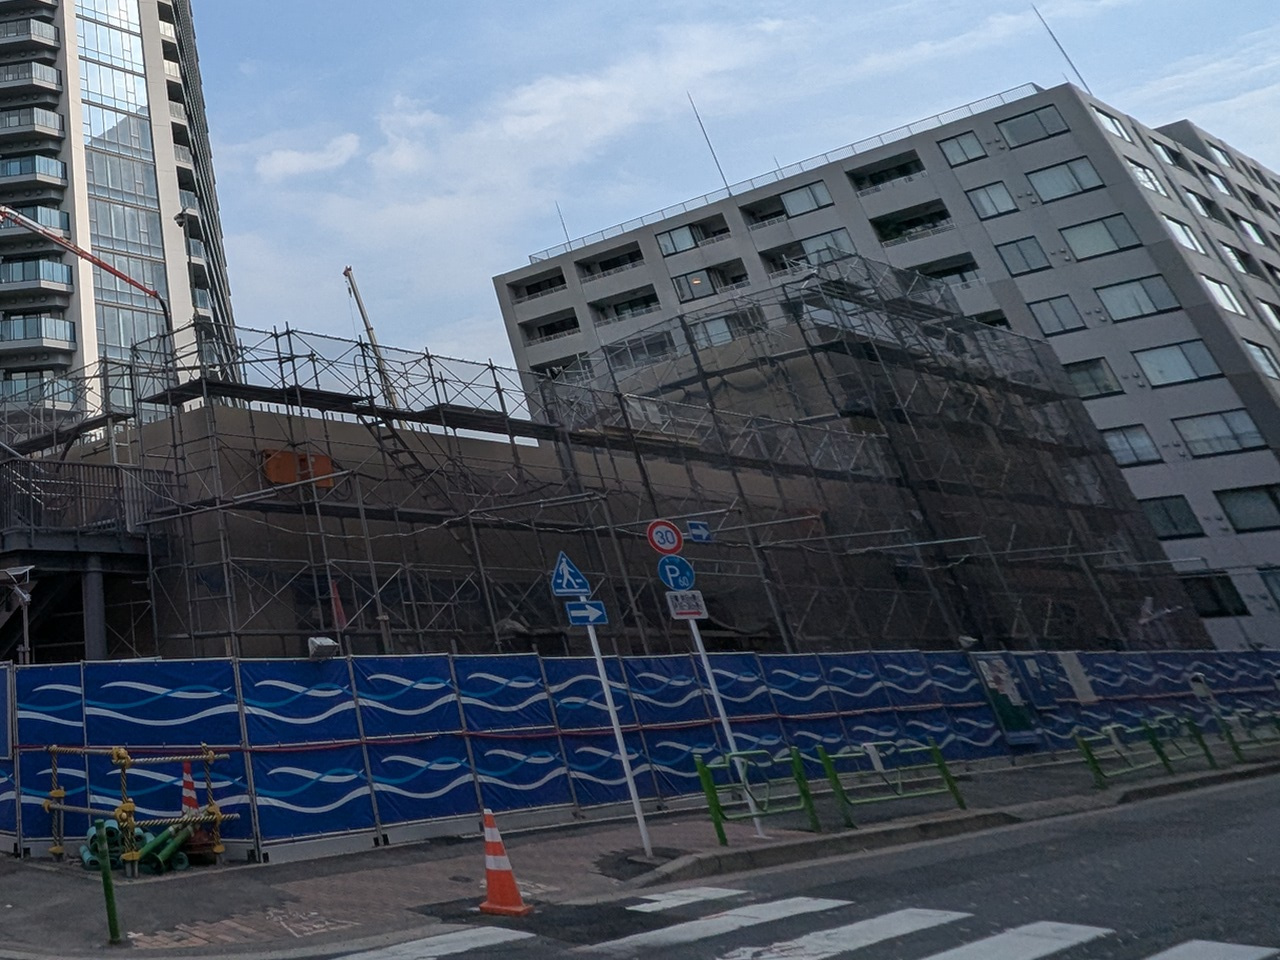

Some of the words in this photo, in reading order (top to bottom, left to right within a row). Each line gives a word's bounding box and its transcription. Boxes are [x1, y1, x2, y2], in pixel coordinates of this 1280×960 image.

[655, 530, 676, 545] 30
[665, 564, 680, 588] P
[678, 576, 690, 587] 60
